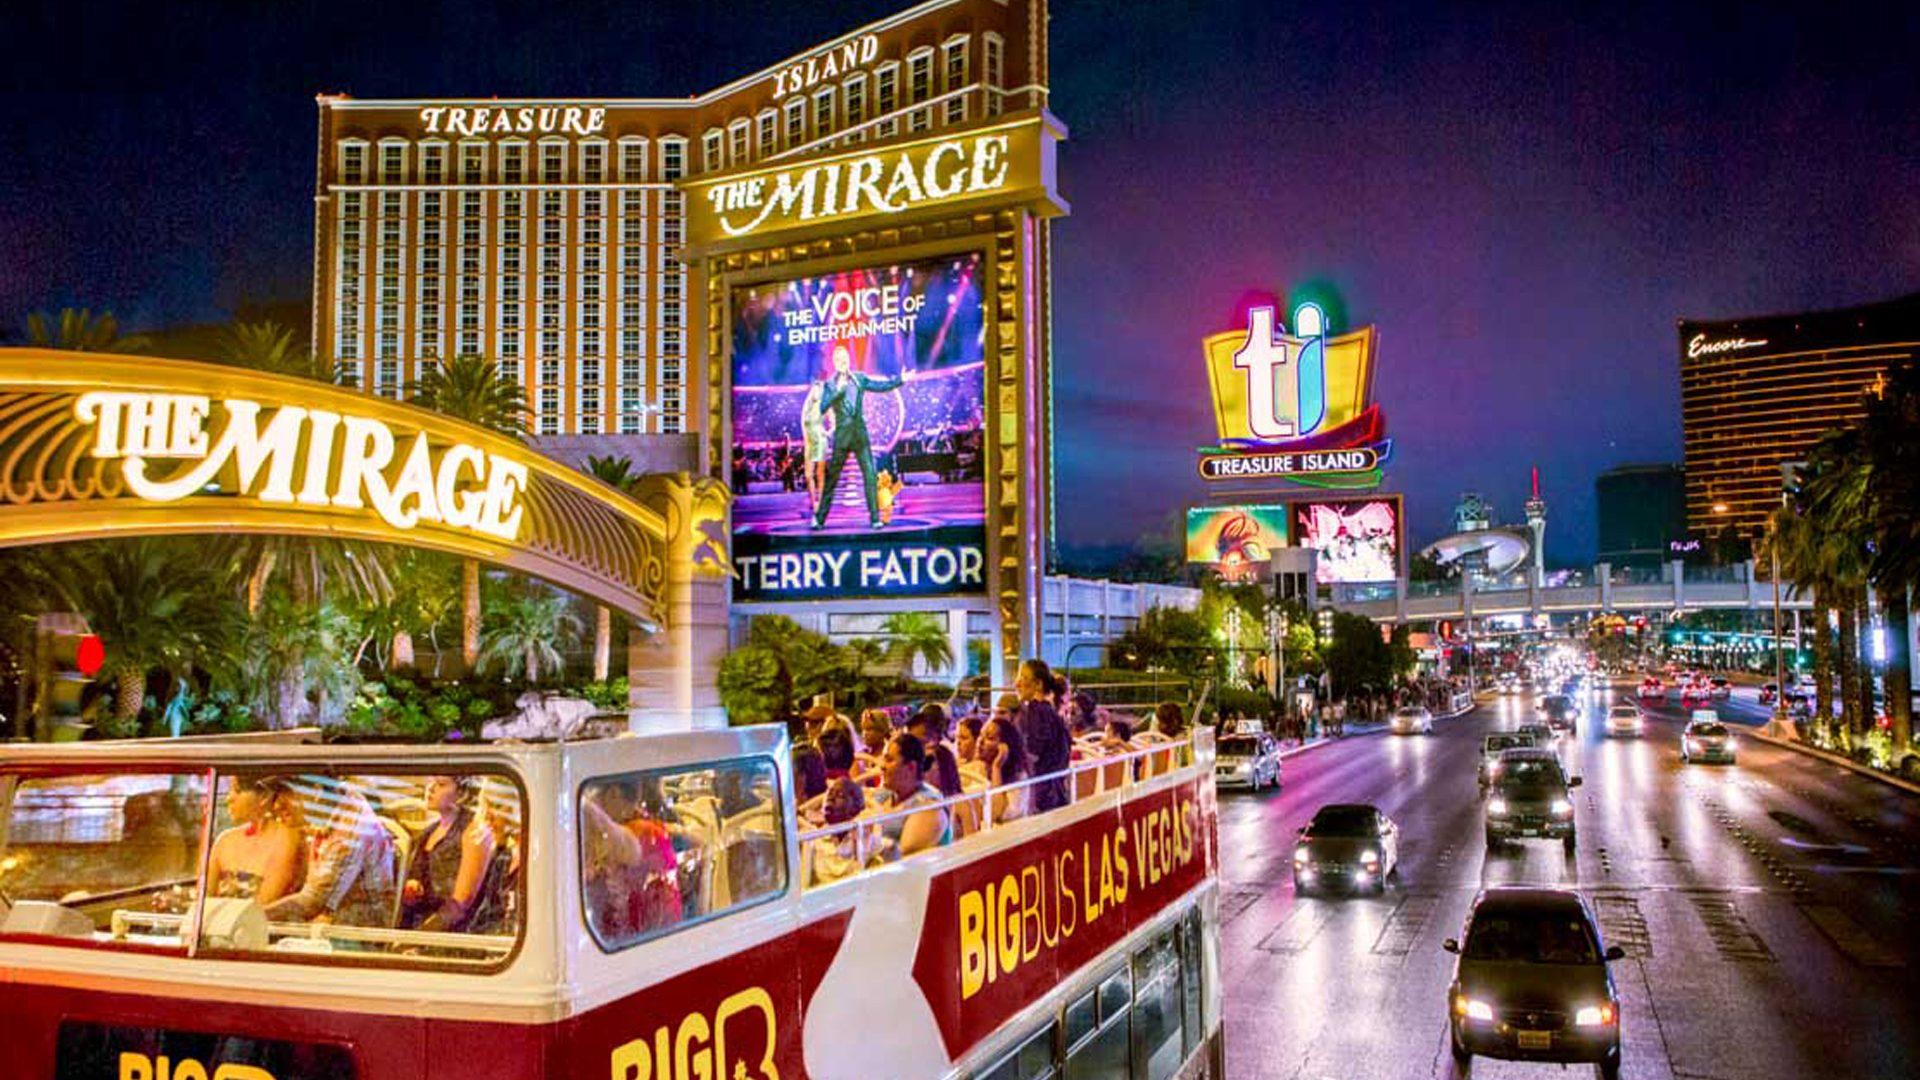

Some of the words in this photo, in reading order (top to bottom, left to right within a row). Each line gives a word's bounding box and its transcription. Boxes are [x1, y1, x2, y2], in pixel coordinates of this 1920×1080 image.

[420, 107, 606, 136] TREASURE
[772, 34, 879, 99] ISLAND
[707, 177, 765, 214] THE
[720, 134, 1009, 236] MIRAGE
[783, 309, 813, 327] THE
[811, 284, 899, 323] VOICE
[902, 294, 926, 313] OF
[788, 314, 917, 346] ENTERTAINMENT
[1687, 332, 1769, 358] Encore
[73, 391, 211, 459] THE
[122, 399, 529, 541] MIRAGE
[1211, 456, 1294, 476] TREASURE
[1302, 452, 1366, 470] ISLAND
[735, 551, 851, 590] TERRY
[860, 546, 984, 587] FATOR
[1083, 826, 1130, 924] LAS
[1132, 799, 1193, 890] VEGAS
